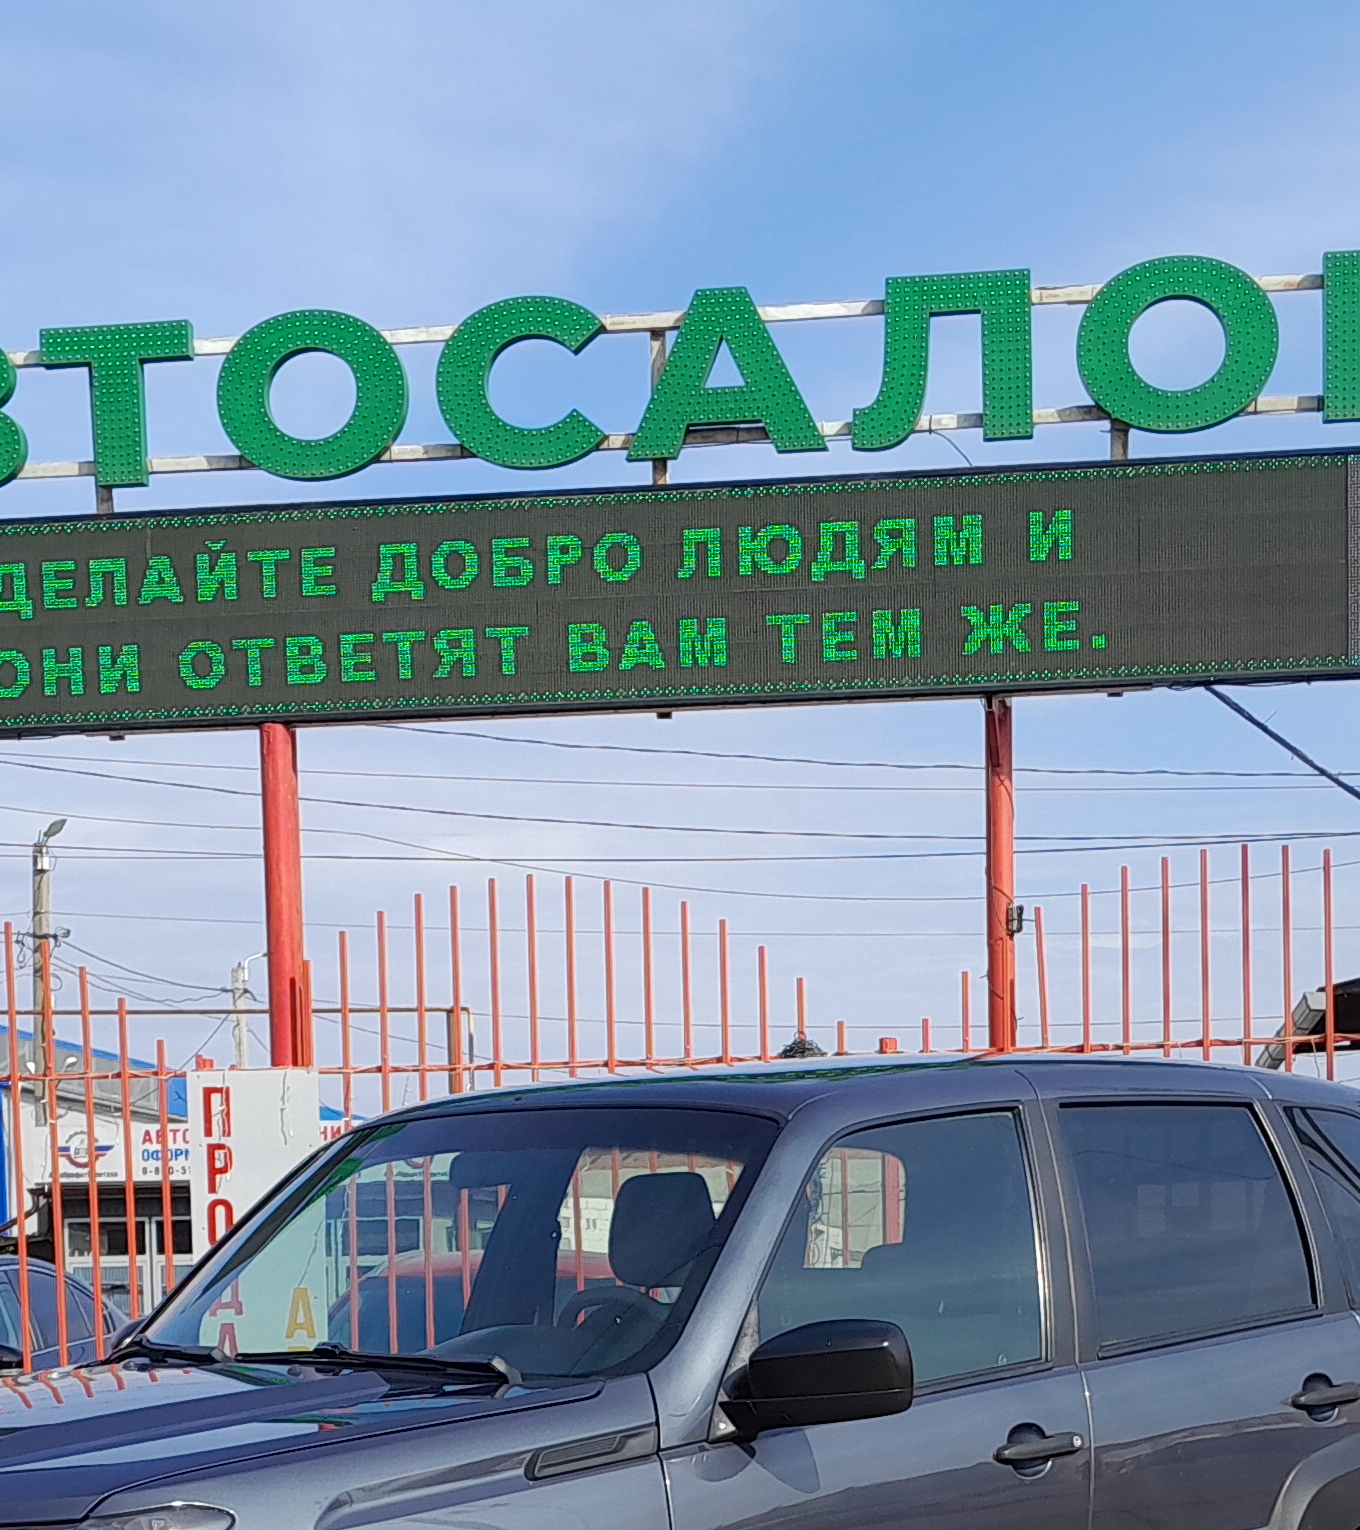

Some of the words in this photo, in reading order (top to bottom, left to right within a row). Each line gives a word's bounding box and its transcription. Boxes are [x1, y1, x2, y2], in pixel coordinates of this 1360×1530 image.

[371, 532, 643, 604] ДОБРО
[677, 514, 985, 584] ЛЮДЯМ
[1029, 509, 1075, 563] И
[179, 626, 531, 691] ОТВЕТЯТ
[567, 617, 729, 674] ВАМ
[765, 608, 923, 665] ТЕМ
[962, 601, 1107, 657] ЖЕ.
